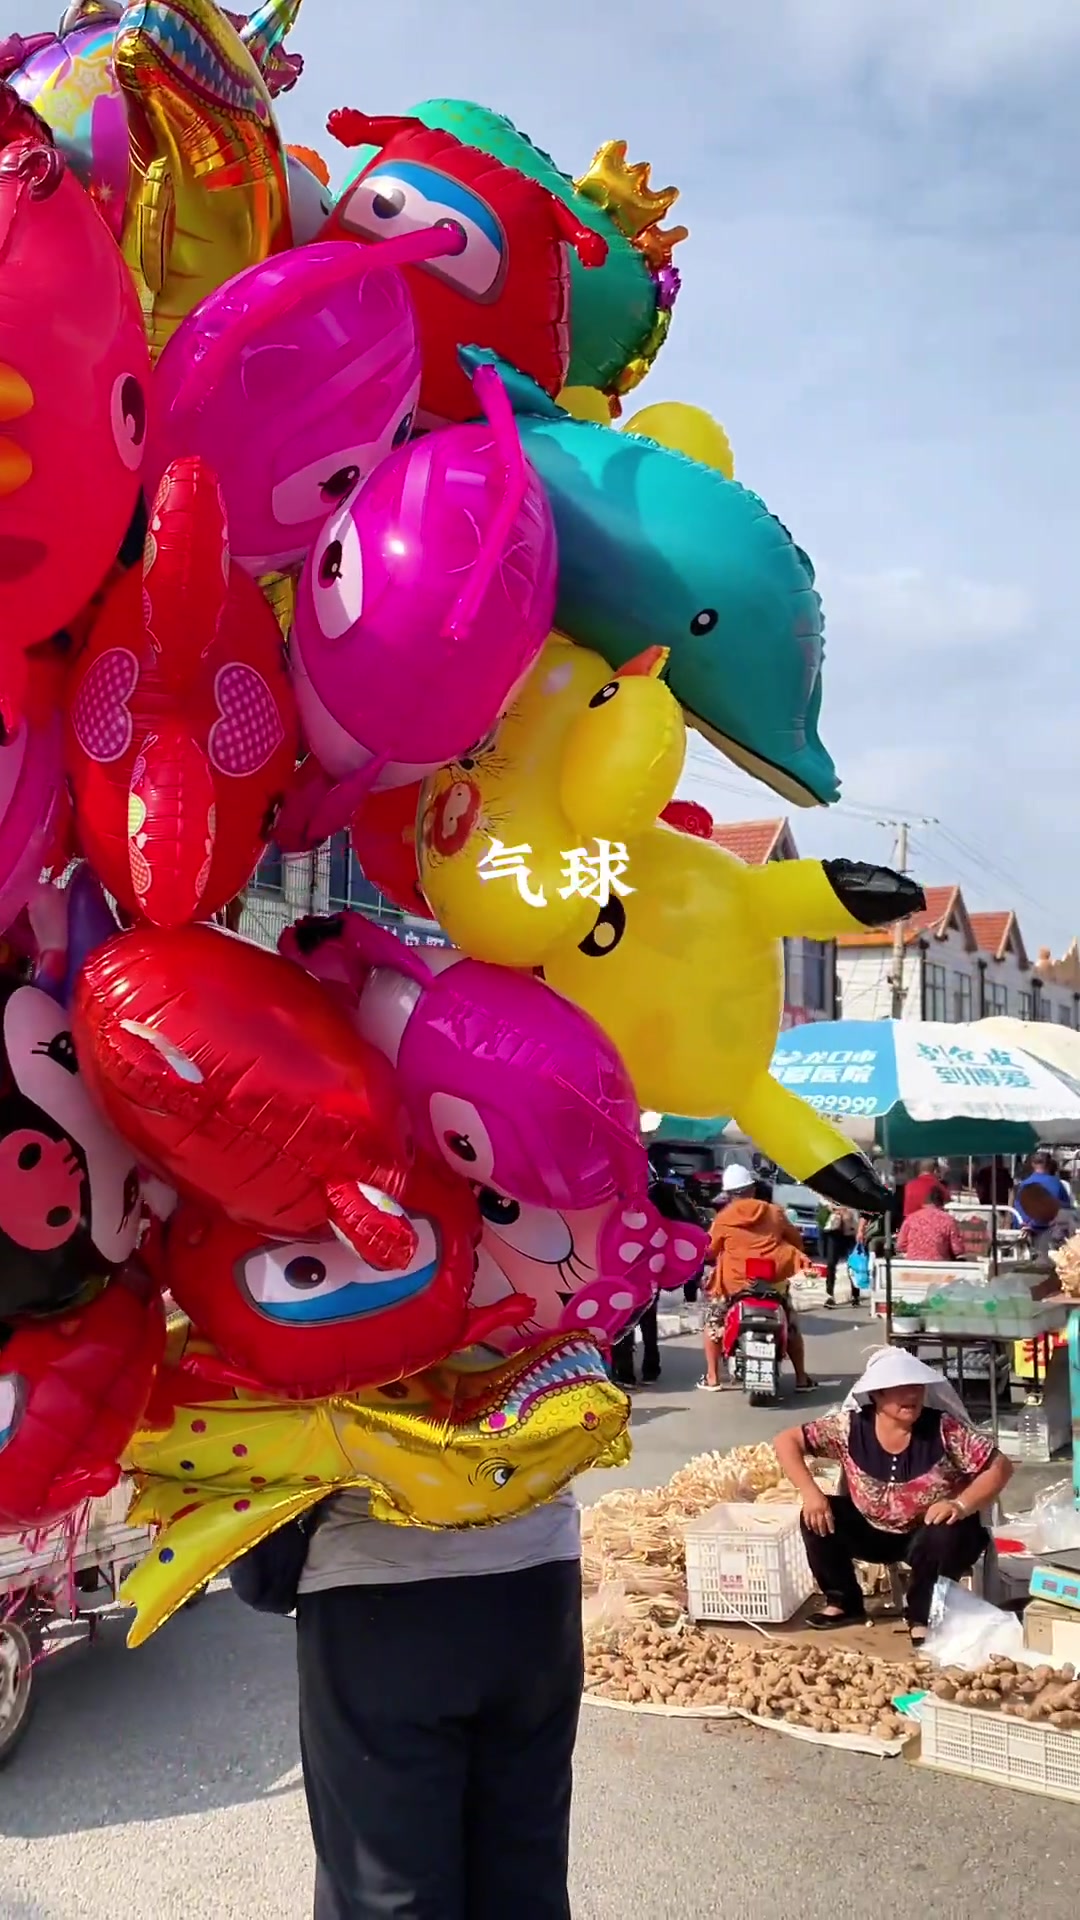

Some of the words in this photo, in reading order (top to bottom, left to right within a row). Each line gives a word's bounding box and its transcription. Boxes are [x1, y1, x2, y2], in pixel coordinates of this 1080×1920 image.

[802, 1049, 878, 1064] 龙口市
[931, 1065, 1037, 1090] 到博爱
